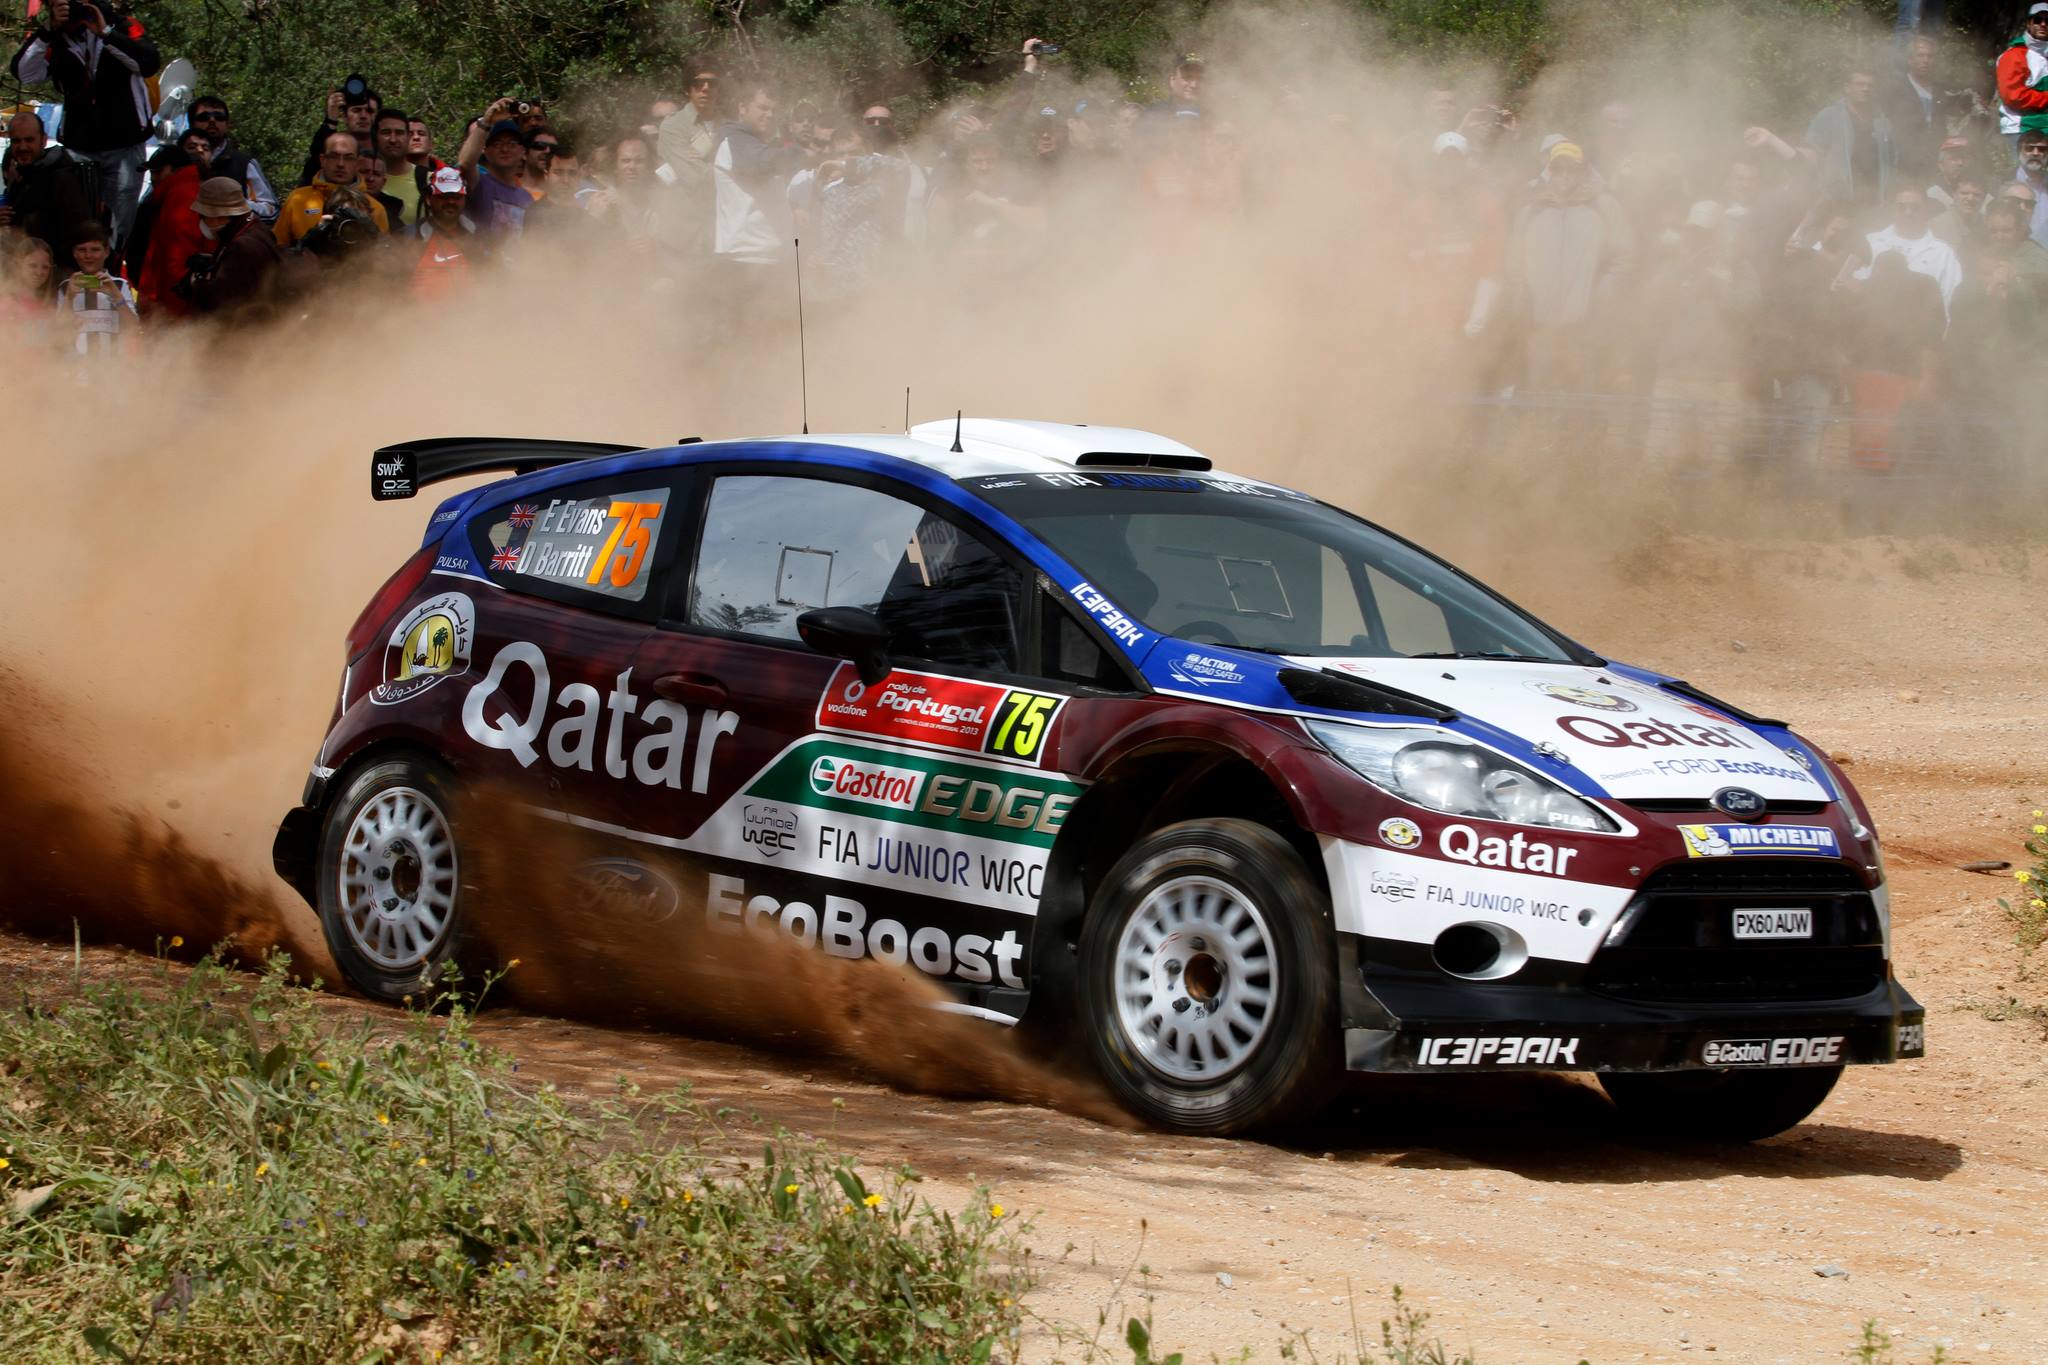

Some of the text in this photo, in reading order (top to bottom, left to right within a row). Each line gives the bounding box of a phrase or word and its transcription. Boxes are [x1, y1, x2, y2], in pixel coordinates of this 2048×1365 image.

[377, 463, 399, 476] SWP
[1035, 473, 1103, 487] FIA
[540, 499, 607, 535] E Evans
[586, 501, 662, 588] 75
[436, 556, 469, 570] PULSAR
[516, 541, 594, 578] D Barritt
[1192, 665, 1215, 676] ROAD
[1214, 669, 1246, 682] SAFETY
[1198, 656, 1237, 672] ACTION
[886, 683, 927, 694] rally de
[461, 641, 740, 795] Qatar
[827, 703, 867, 717] vodafone
[876, 690, 986, 724] Portugal
[960, 725, 979, 736] 2013
[993, 692, 1063, 756] 75
[1556, 716, 1754, 750] Qatar
[1653, 758, 1719, 777] FORD
[1715, 759, 1815, 785] EcoBoost
[835, 764, 1081, 835] Castrol EDGE
[1727, 792, 1756, 810] Ford
[747, 815, 794, 830] JUNIOR
[1548, 813, 1598, 829] PIAA
[743, 826, 796, 851] WRC
[1439, 824, 1578, 876] Qatar
[1727, 827, 1834, 848] MICHELIN
[818, 825, 1043, 901] FIA JUNIOR WRC
[1371, 883, 1416, 899] WRC
[1426, 885, 1570, 922] FIA JUNIOR WRC
[705, 872, 1026, 990] EcoBoost
[1736, 912, 1810, 934] PX60 AUW
[1718, 1036, 1845, 1065] Castrol EDGE
